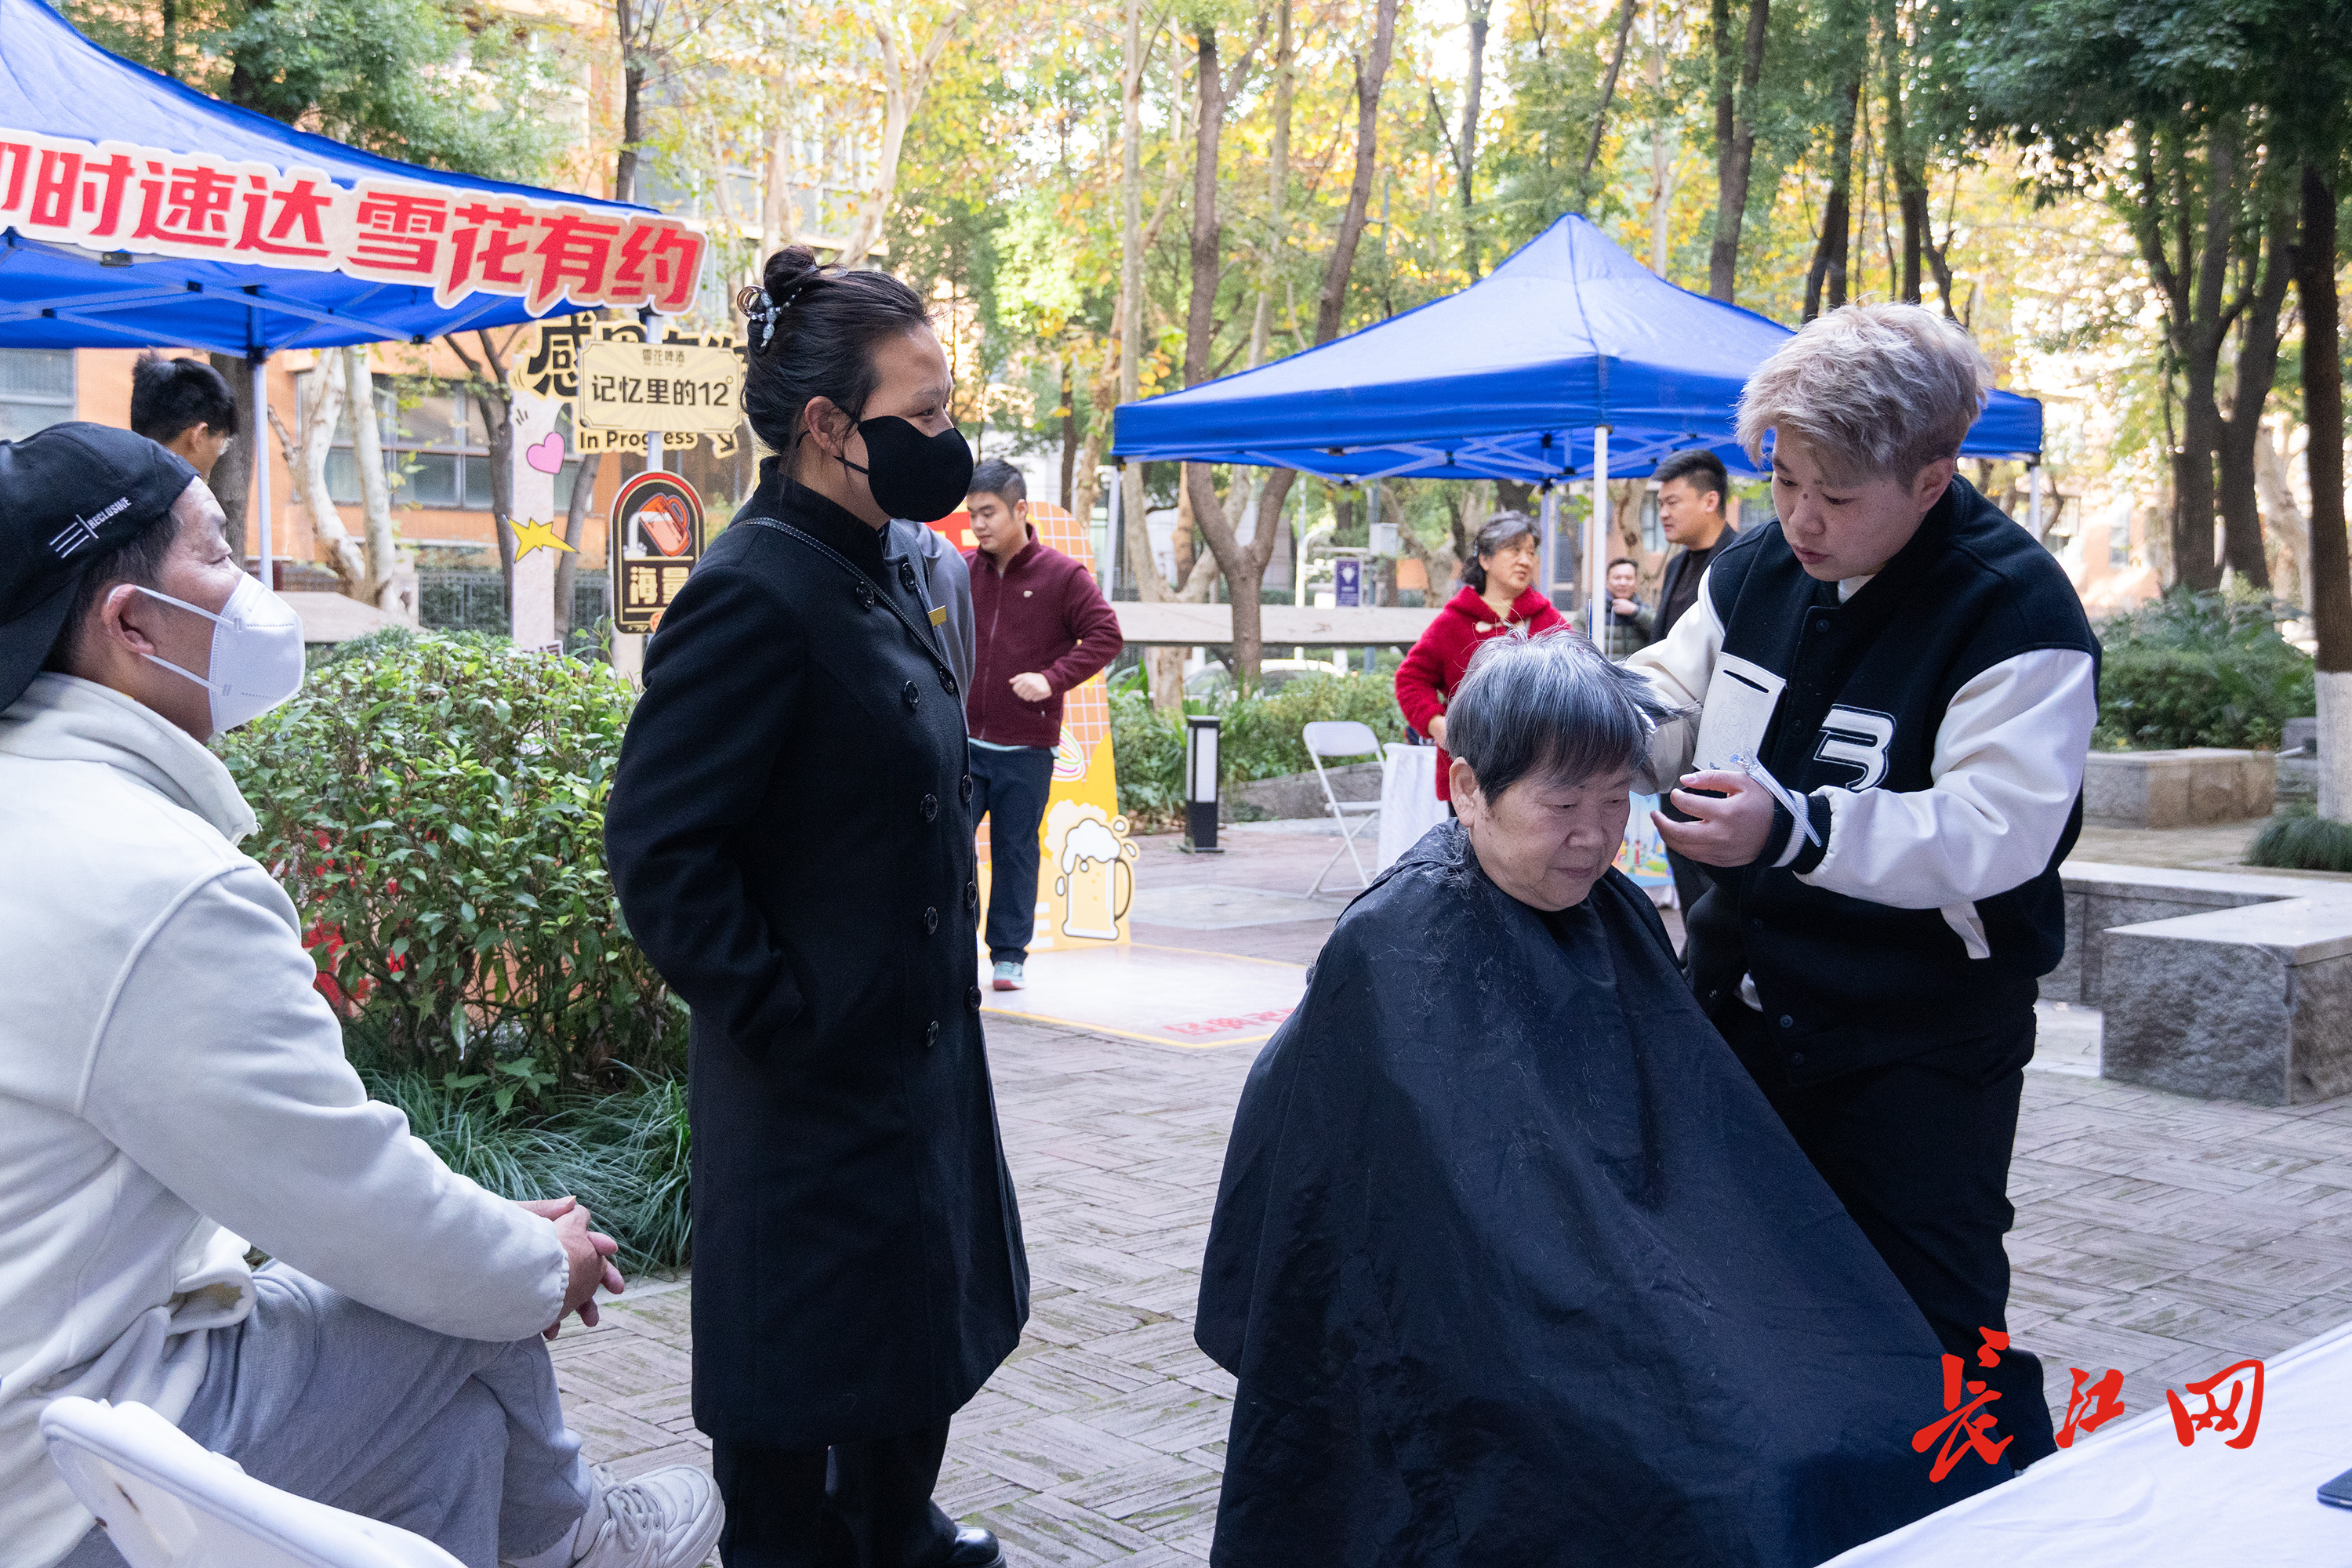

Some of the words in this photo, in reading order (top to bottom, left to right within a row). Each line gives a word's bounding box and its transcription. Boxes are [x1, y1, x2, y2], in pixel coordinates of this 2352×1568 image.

[349, 191, 702, 307] 雪花有约
[580, 431, 599, 448] In
[607, 430, 695, 451] Proess
